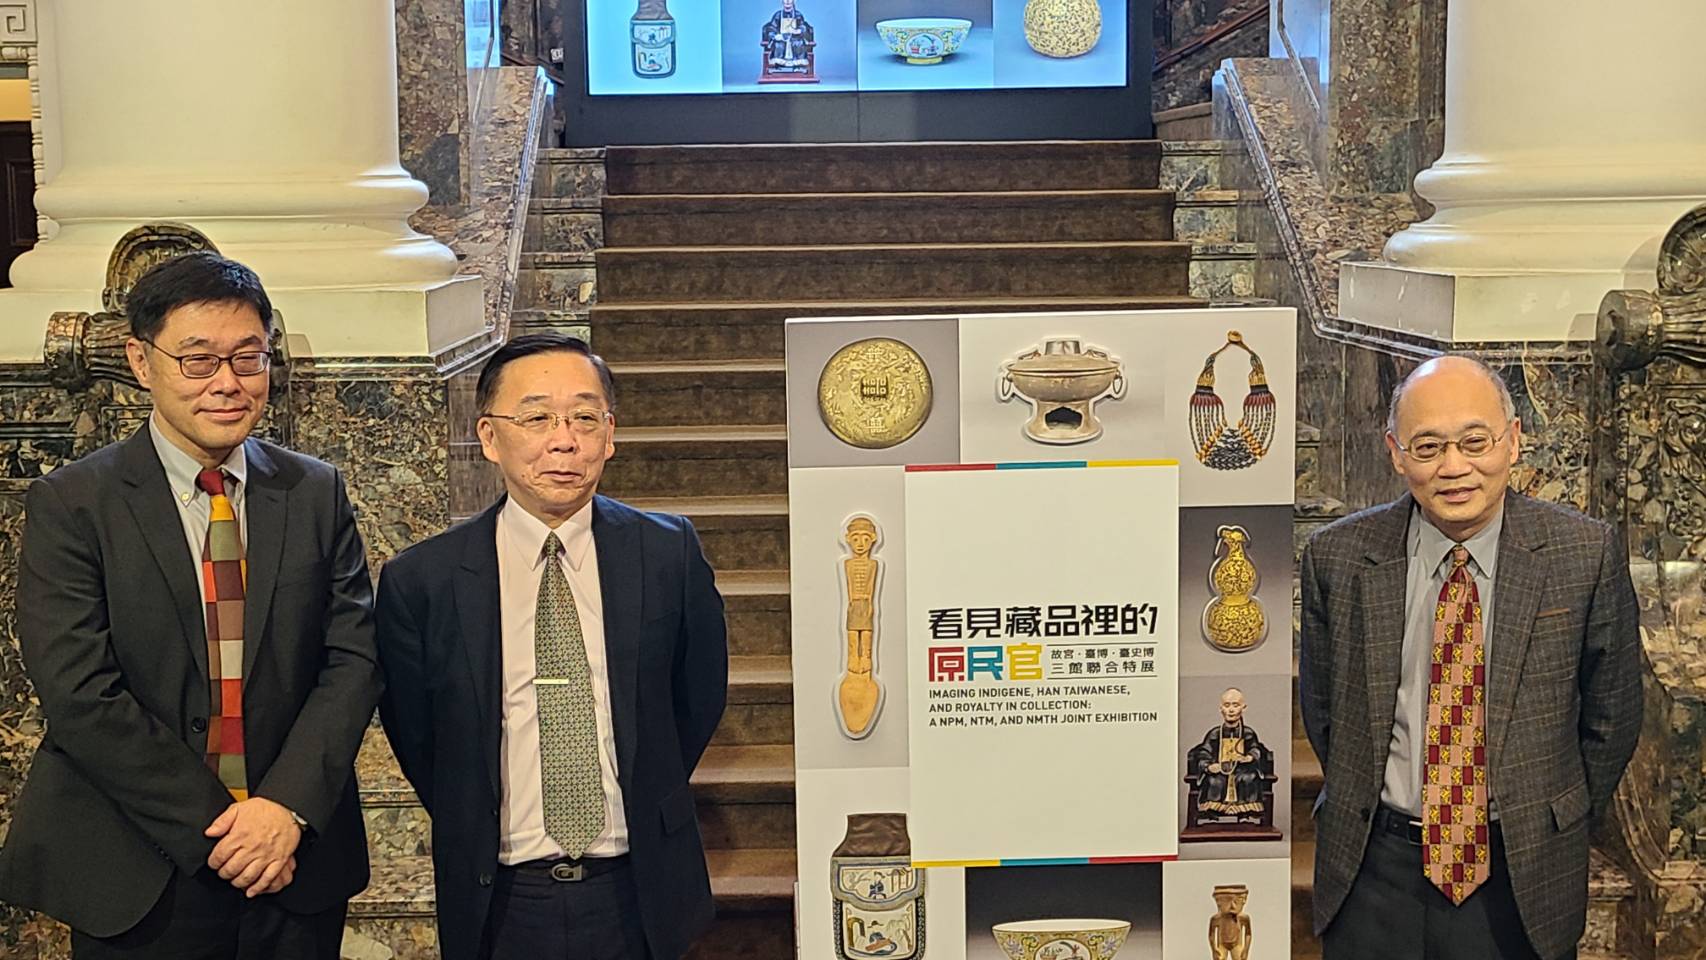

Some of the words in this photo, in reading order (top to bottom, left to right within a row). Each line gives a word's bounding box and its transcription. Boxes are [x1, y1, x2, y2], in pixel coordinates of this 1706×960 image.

[928, 603, 1157, 639] 看見藏品裡的
[928, 642, 1043, 681] 原民官
[1051, 661, 1154, 674] 三館聯合特展
[929, 689, 975, 698] IMAGING
[979, 688, 1034, 698] INDIGENE,
[1037, 687, 1060, 696] HAN
[1064, 685, 1130, 695] TAIWANESE,
[929, 703, 952, 712] AND
[956, 702, 1001, 712] ROYALTY
[1006, 702, 1016, 711] IN
[1020, 701, 1091, 710] COLLECTION:
[930, 718, 937, 727] A
[940, 717, 967, 726] NPM,
[970, 717, 997, 726] NTM,
[1000, 716, 1022, 725] AND
[1027, 715, 1057, 724] NMTH
[1061, 714, 1091, 723] JOINT
[1096, 712, 1157, 722] EXHIBITION
